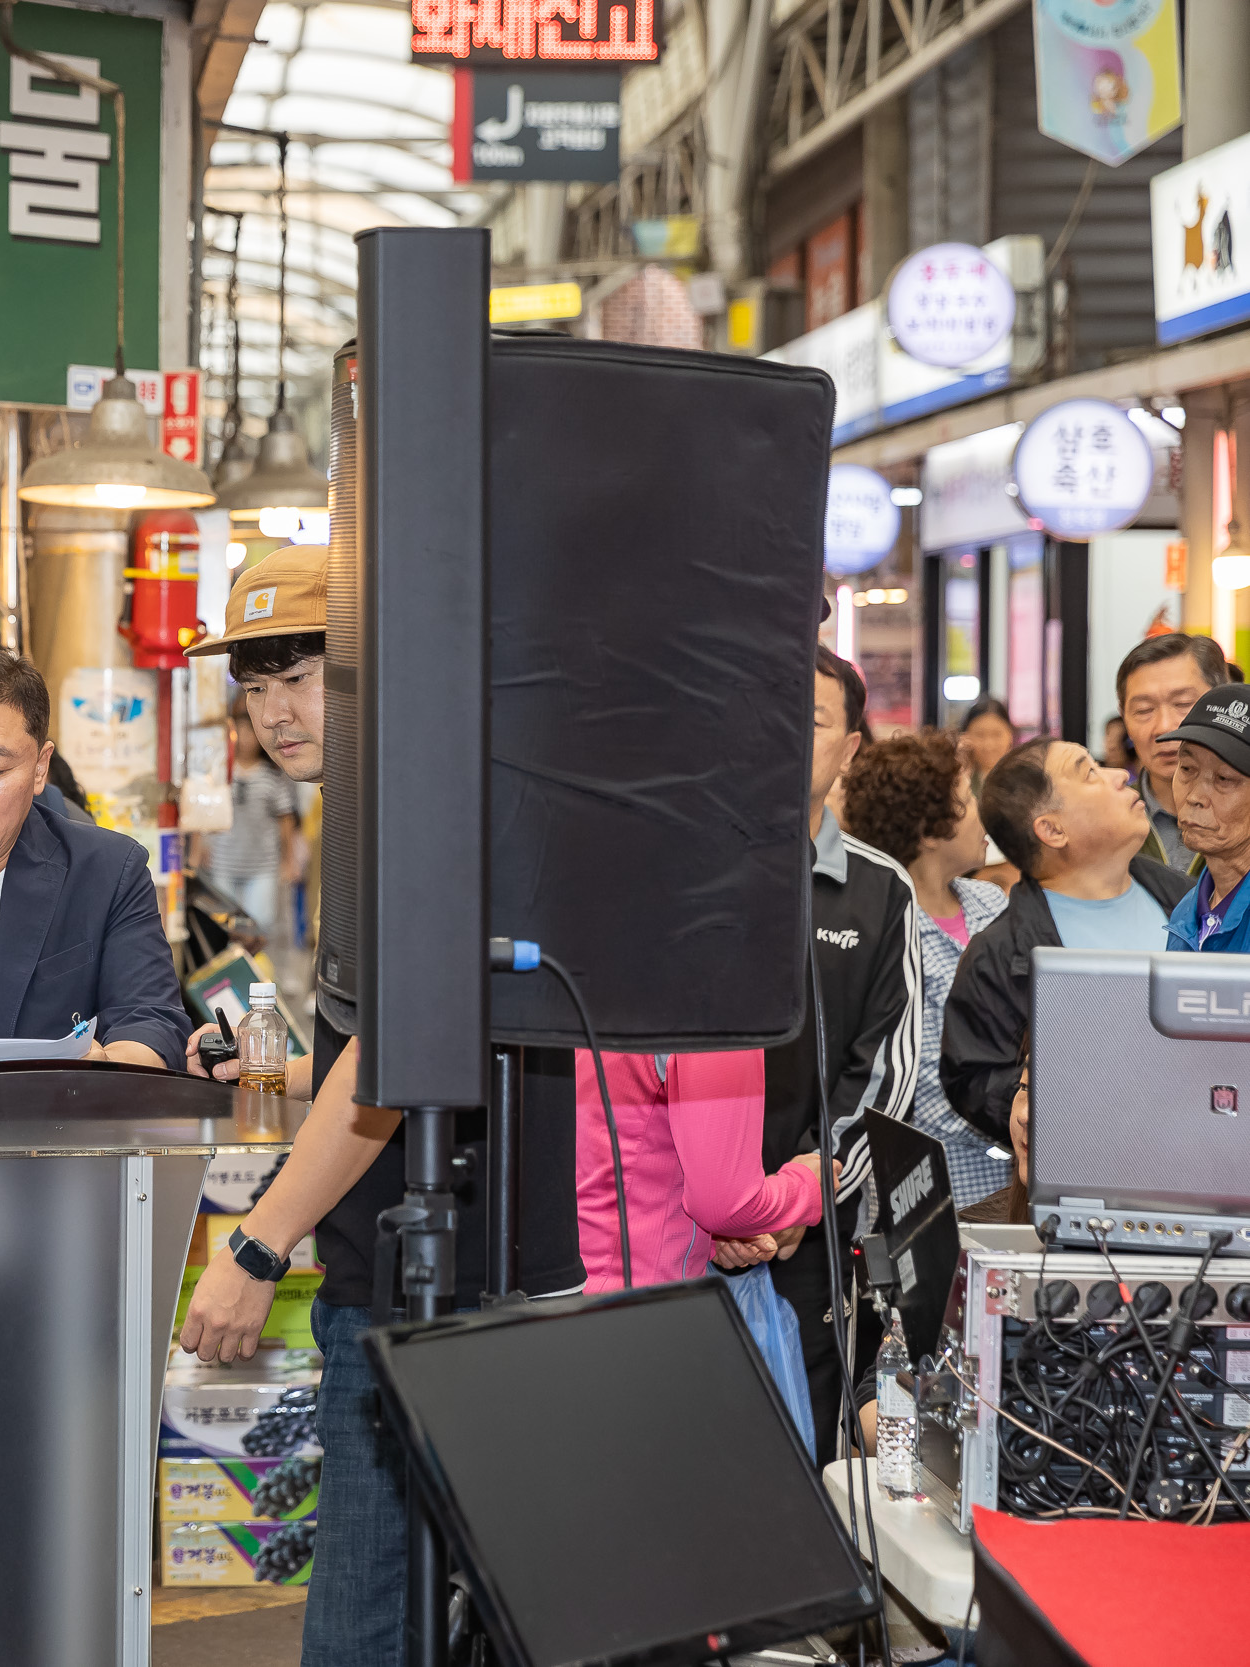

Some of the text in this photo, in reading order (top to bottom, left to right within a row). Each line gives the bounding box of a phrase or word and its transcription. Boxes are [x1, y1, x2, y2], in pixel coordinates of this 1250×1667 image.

[816, 927, 860, 950] KWTF
[1177, 989, 1250, 1017] EL
[889, 1153, 935, 1227] SHURE
